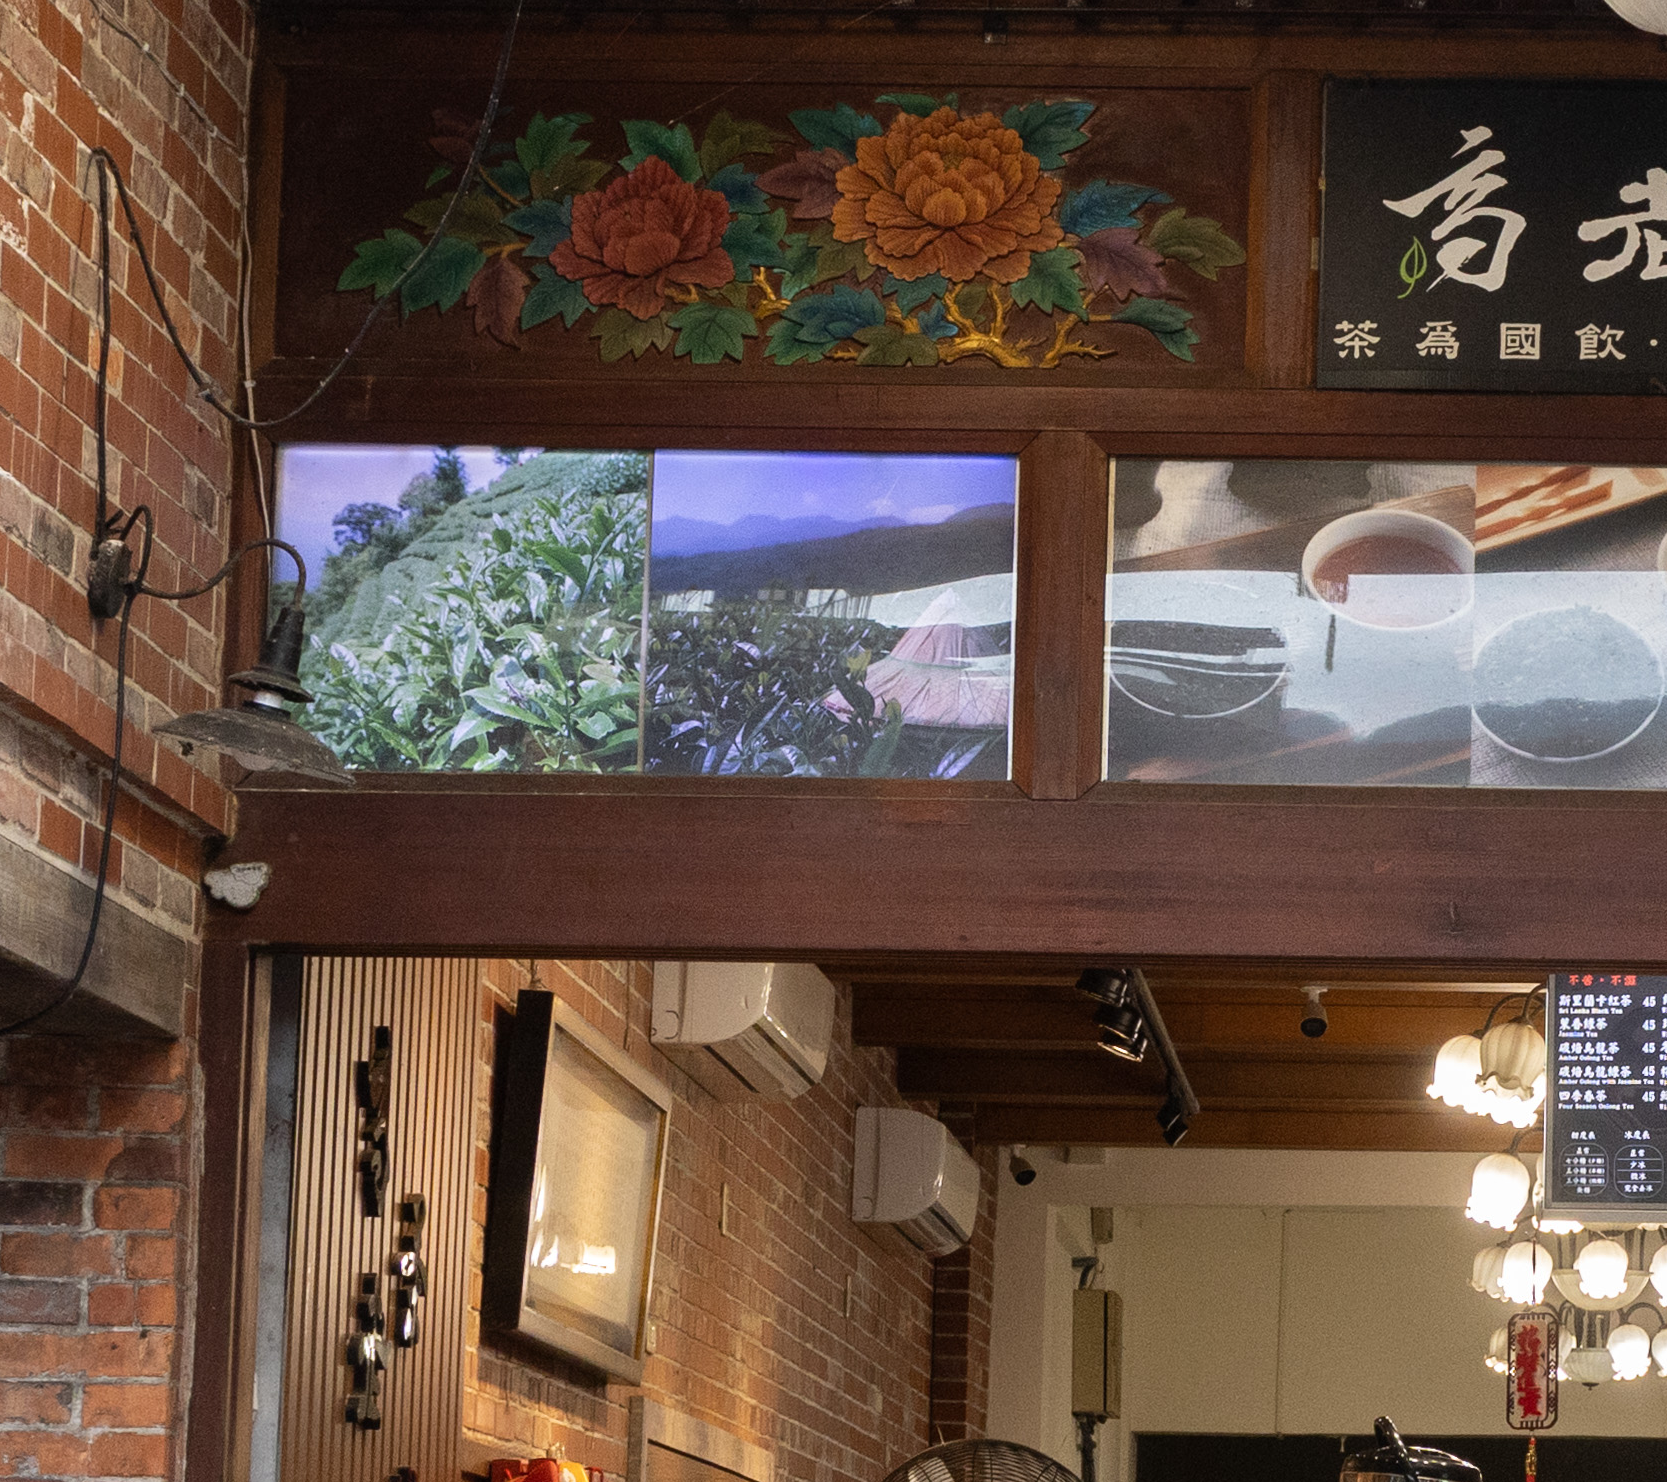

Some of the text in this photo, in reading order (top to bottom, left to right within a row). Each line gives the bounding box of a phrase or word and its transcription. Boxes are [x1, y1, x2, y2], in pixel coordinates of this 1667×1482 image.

[1558, 994, 1657, 1008] 斯里蘭卡紅茶 45
[1558, 1089, 1656, 1103] 四季春茶 45
